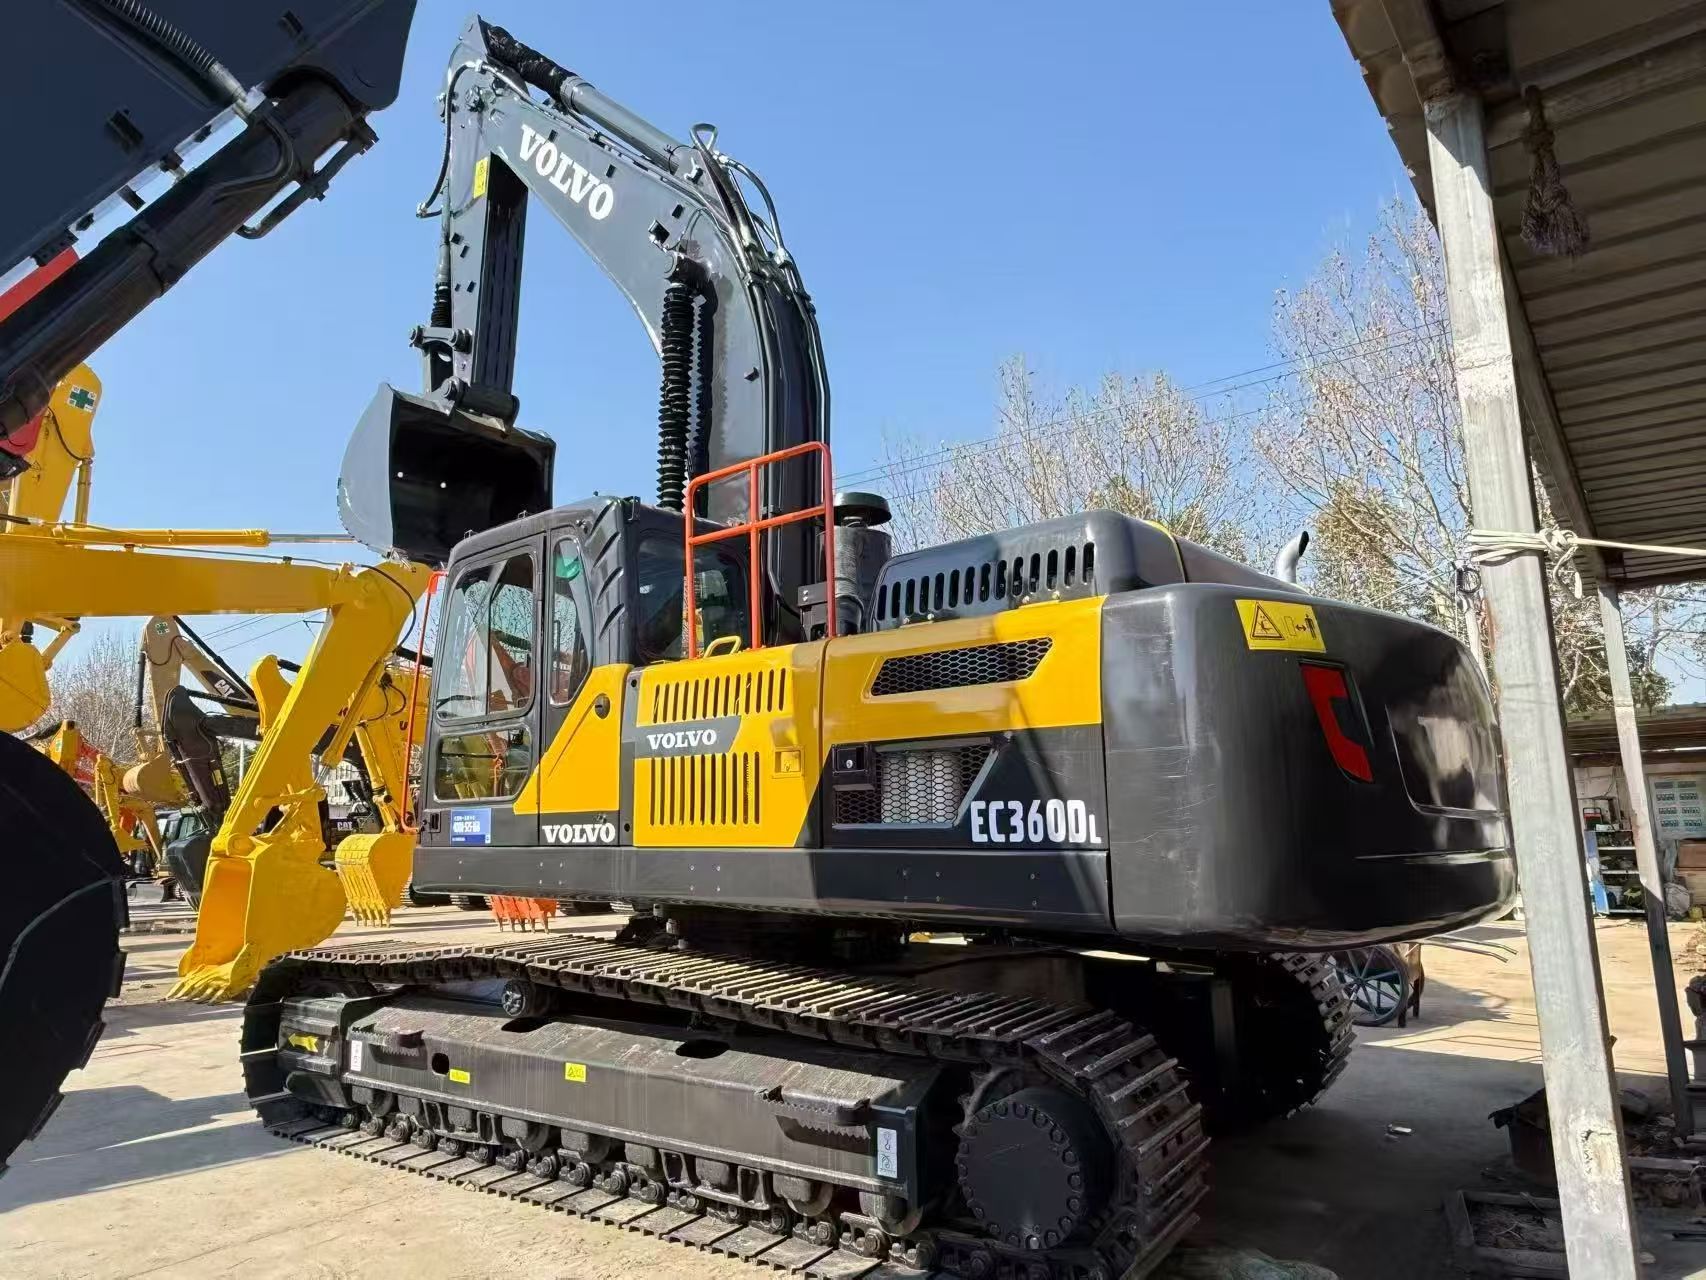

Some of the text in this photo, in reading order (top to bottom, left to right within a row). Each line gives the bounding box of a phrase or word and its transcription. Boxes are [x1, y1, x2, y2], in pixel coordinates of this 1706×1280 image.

[520, 123, 614, 220] VOLVO
[213, 679, 235, 698] CAT
[647, 729, 717, 750] VOLVO
[337, 821, 353, 831] CAT
[970, 799, 1102, 843] EC360DL
[542, 822, 616, 844] VOLVO
